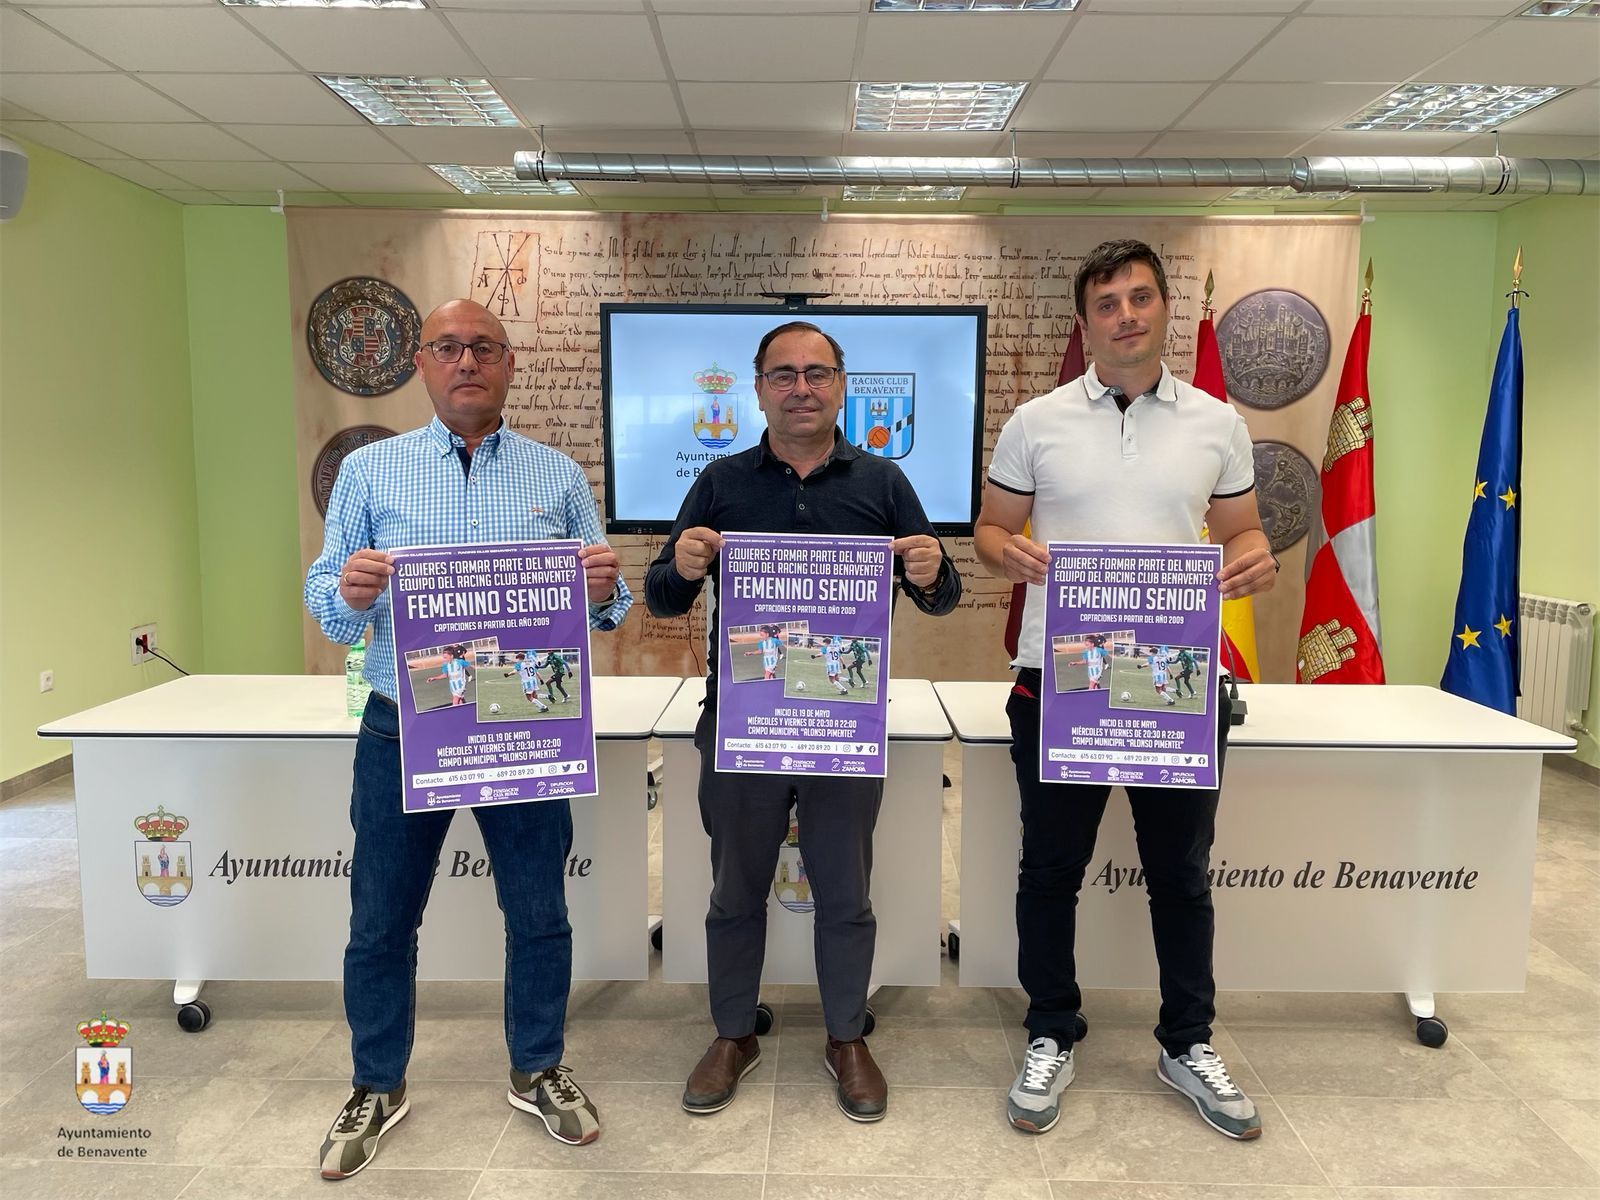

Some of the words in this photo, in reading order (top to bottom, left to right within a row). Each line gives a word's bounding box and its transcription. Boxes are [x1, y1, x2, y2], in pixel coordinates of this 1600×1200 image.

[852, 377, 885, 385] RACING
[886, 377, 909, 385] CLUB
[854, 386, 906, 394] BENAVENTE
[676, 451, 731, 463] Ayuntam
[676, 467, 690, 478] de
[729, 547, 770, 561] ¿QUIERES
[773, 549, 808, 562] FORMAR
[811, 550, 837, 563] PARTE
[839, 551, 854, 563] DEL
[857, 551, 884, 564] NUEVO
[398, 561, 447, 577] ¿QUIERES
[450, 559, 491, 574] FORMAR
[493, 558, 523, 572] PARTE
[526, 557, 543, 571] DEL
[545, 555, 576, 570] NUEVO
[729, 561, 758, 573] EQUIPO
[761, 562, 776, 574] DEL
[778, 562, 808, 575] RACING
[810, 563, 831, 575] CLUB
[834, 564, 884, 577] BENAVENTE?
[1055, 557, 1097, 570] ¿QUIERES
[1100, 558, 1136, 571] FORMAR
[1138, 559, 1165, 571] PARTE
[1168, 559, 1183, 572] DEL
[1186, 560, 1214, 572] NUEVO
[399, 577, 435, 592] EQUIPO
[438, 576, 455, 589] DEL
[457, 574, 492, 588] RACING
[494, 573, 518, 586] CLUB
[520, 570, 577, 585] BENAVENTE?
[1055, 570, 1085, 583] EQUIPO
[1088, 571, 1103, 583] DEL
[1105, 571, 1135, 584] RACING
[1138, 572, 1159, 584] CLUB
[1162, 573, 1214, 586] BENAVENTE?
[734, 576, 814, 601] FEMENINO
[819, 579, 877, 603] SENIOR
[407, 590, 501, 620] FEMENINO
[505, 586, 572, 614] SENIOR
[1059, 585, 1141, 610] FEMENINO
[1146, 588, 1207, 612] SENIOR
[755, 604, 791, 613] CAPTACIONES
[792, 605, 796, 613] A
[797, 605, 816, 614] PARTIR
[818, 606, 827, 614] DEL
[828, 605, 840, 615] AÑO
[841, 607, 856, 615] 2009
[434, 622, 477, 633] CAPTACIONES
[477, 621, 483, 630] A
[483, 620, 506, 630] PARTIR
[506, 619, 518, 628] DEL
[518, 617, 532, 627] AÑO
[533, 617, 550, 627] 2009
[1081, 614, 1118, 623] CAPTACIONES
[1119, 615, 1123, 623] A
[1124, 615, 1144, 623] PARTIR
[1145, 615, 1155, 624] DEL
[1156, 614, 1168, 624] AÑO
[1169, 616, 1184, 624] 2009
[775, 708, 791, 717] INICIO
[792, 709, 799, 717] EL
[799, 709, 806, 717] 19
[807, 709, 814, 718] DE
[815, 709, 830, 718] MAYO
[747, 716, 778, 726] MIÉRCOLES
[779, 718, 784, 726] Y
[784, 718, 807, 727] VIERNES
[808, 719, 815, 727] DE
[817, 719, 833, 728] 20:30
[834, 720, 839, 728] A
[840, 720, 857, 729] 22:00
[1100, 718, 1117, 727] INICIO
[1118, 719, 1124, 728] EL
[1125, 719, 1132, 728] 19
[1133, 720, 1140, 728] DE
[1141, 720, 1157, 729] MAYO
[468, 734, 487, 745] INICIO
[488, 733, 495, 743] EL
[496, 733, 503, 742] 19
[504, 732, 513, 742] DE
[513, 730, 531, 741] MAYO
[1072, 726, 1104, 737] MIÉRCOLES
[1105, 729, 1109, 737] Y
[1110, 729, 1133, 738] VIERNES
[1134, 730, 1142, 738] DE
[1143, 730, 1160, 739] 20:30
[1161, 731, 1166, 739] A
[1167, 731, 1184, 740] 22:00
[437, 745, 473, 758] MIÉRCOLES
[474, 745, 480, 755] Y
[480, 743, 506, 754] VIERNES
[507, 742, 515, 752] DE
[516, 741, 536, 751] 20:30
[536, 740, 542, 749] A
[543, 738, 562, 749] 22:00
[209, 849, 353, 885] Ayuntamie
[1091, 859, 1284, 894] Ayuiento
[1293, 861, 1326, 889] de
[1333, 862, 1479, 890] Benavente
